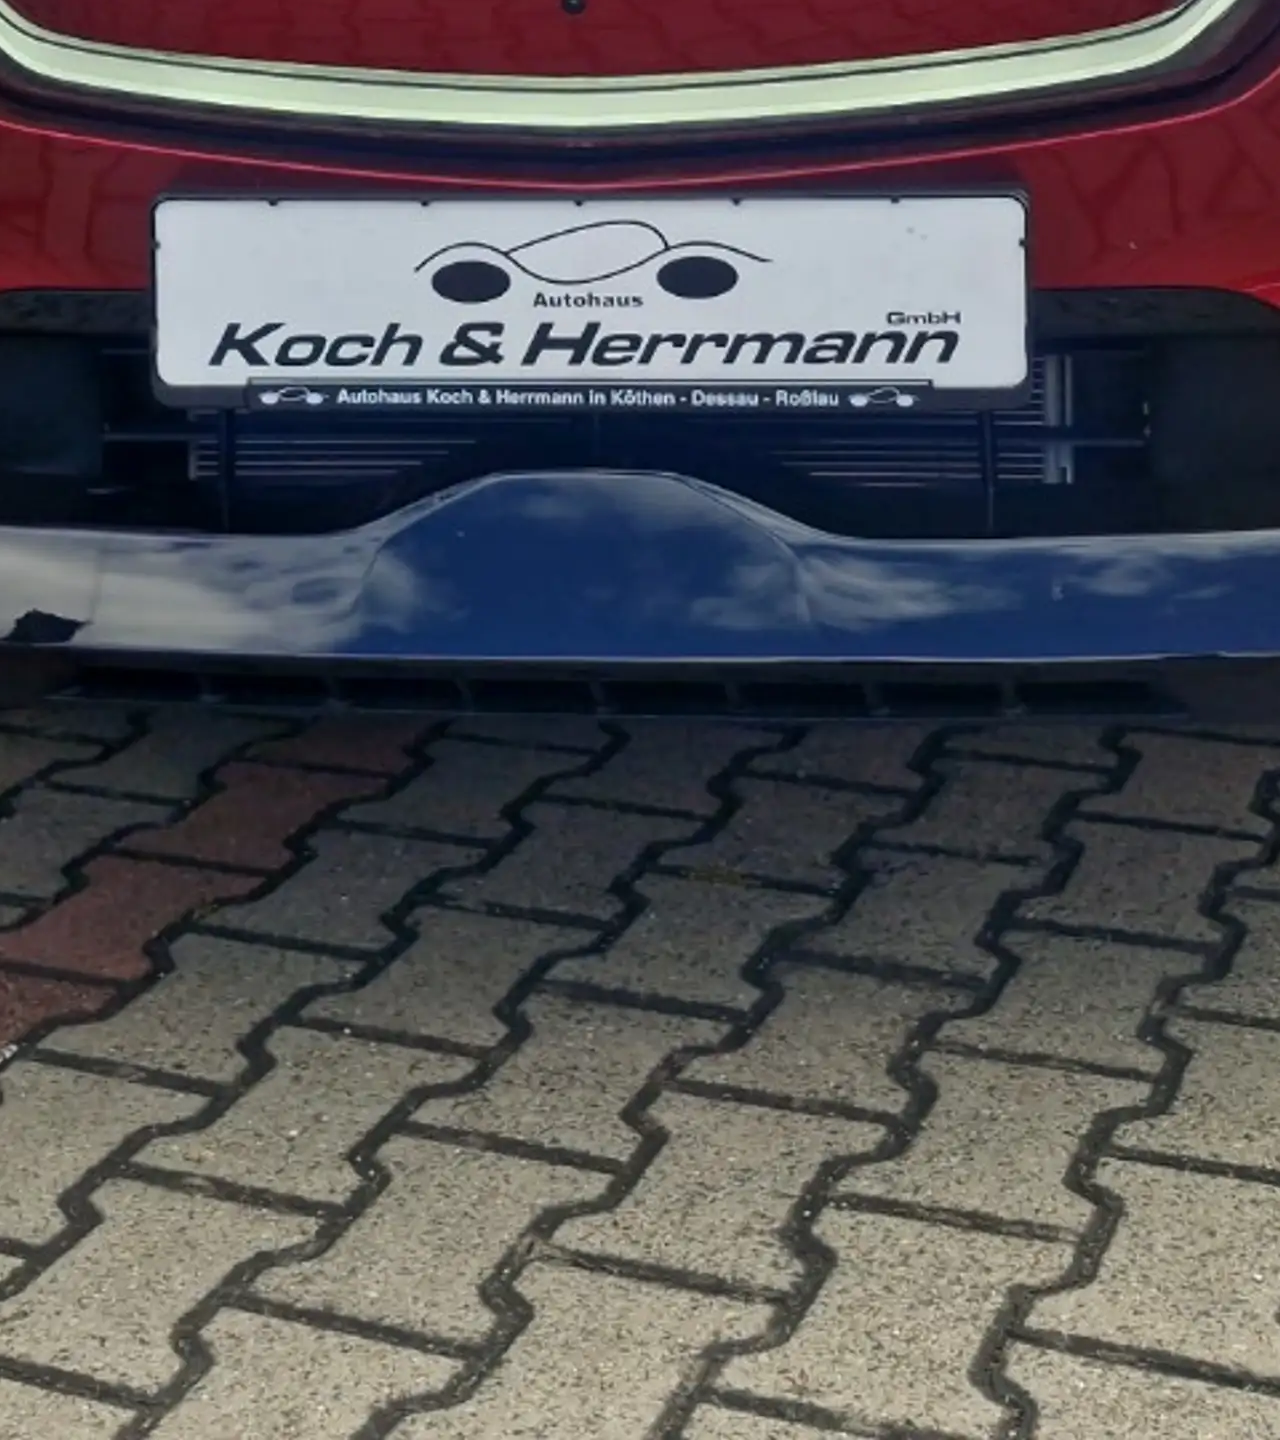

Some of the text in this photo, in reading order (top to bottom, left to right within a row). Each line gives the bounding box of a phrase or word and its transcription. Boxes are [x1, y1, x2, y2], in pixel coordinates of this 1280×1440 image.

[533, 292, 644, 308] Autohaus
[886, 311, 962, 325] GmbH
[208, 321, 960, 366] Koch & Herrmann
[336, 389, 422, 405] Autohaus
[427, 388, 473, 405] Koch
[477, 389, 491, 405] &
[496, 389, 584, 405] Herrmann
[589, 389, 606, 405] in
[610, 389, 676, 406] Köthen
[691, 389, 760, 407] Dessau
[775, 389, 840, 407] Roßlau
